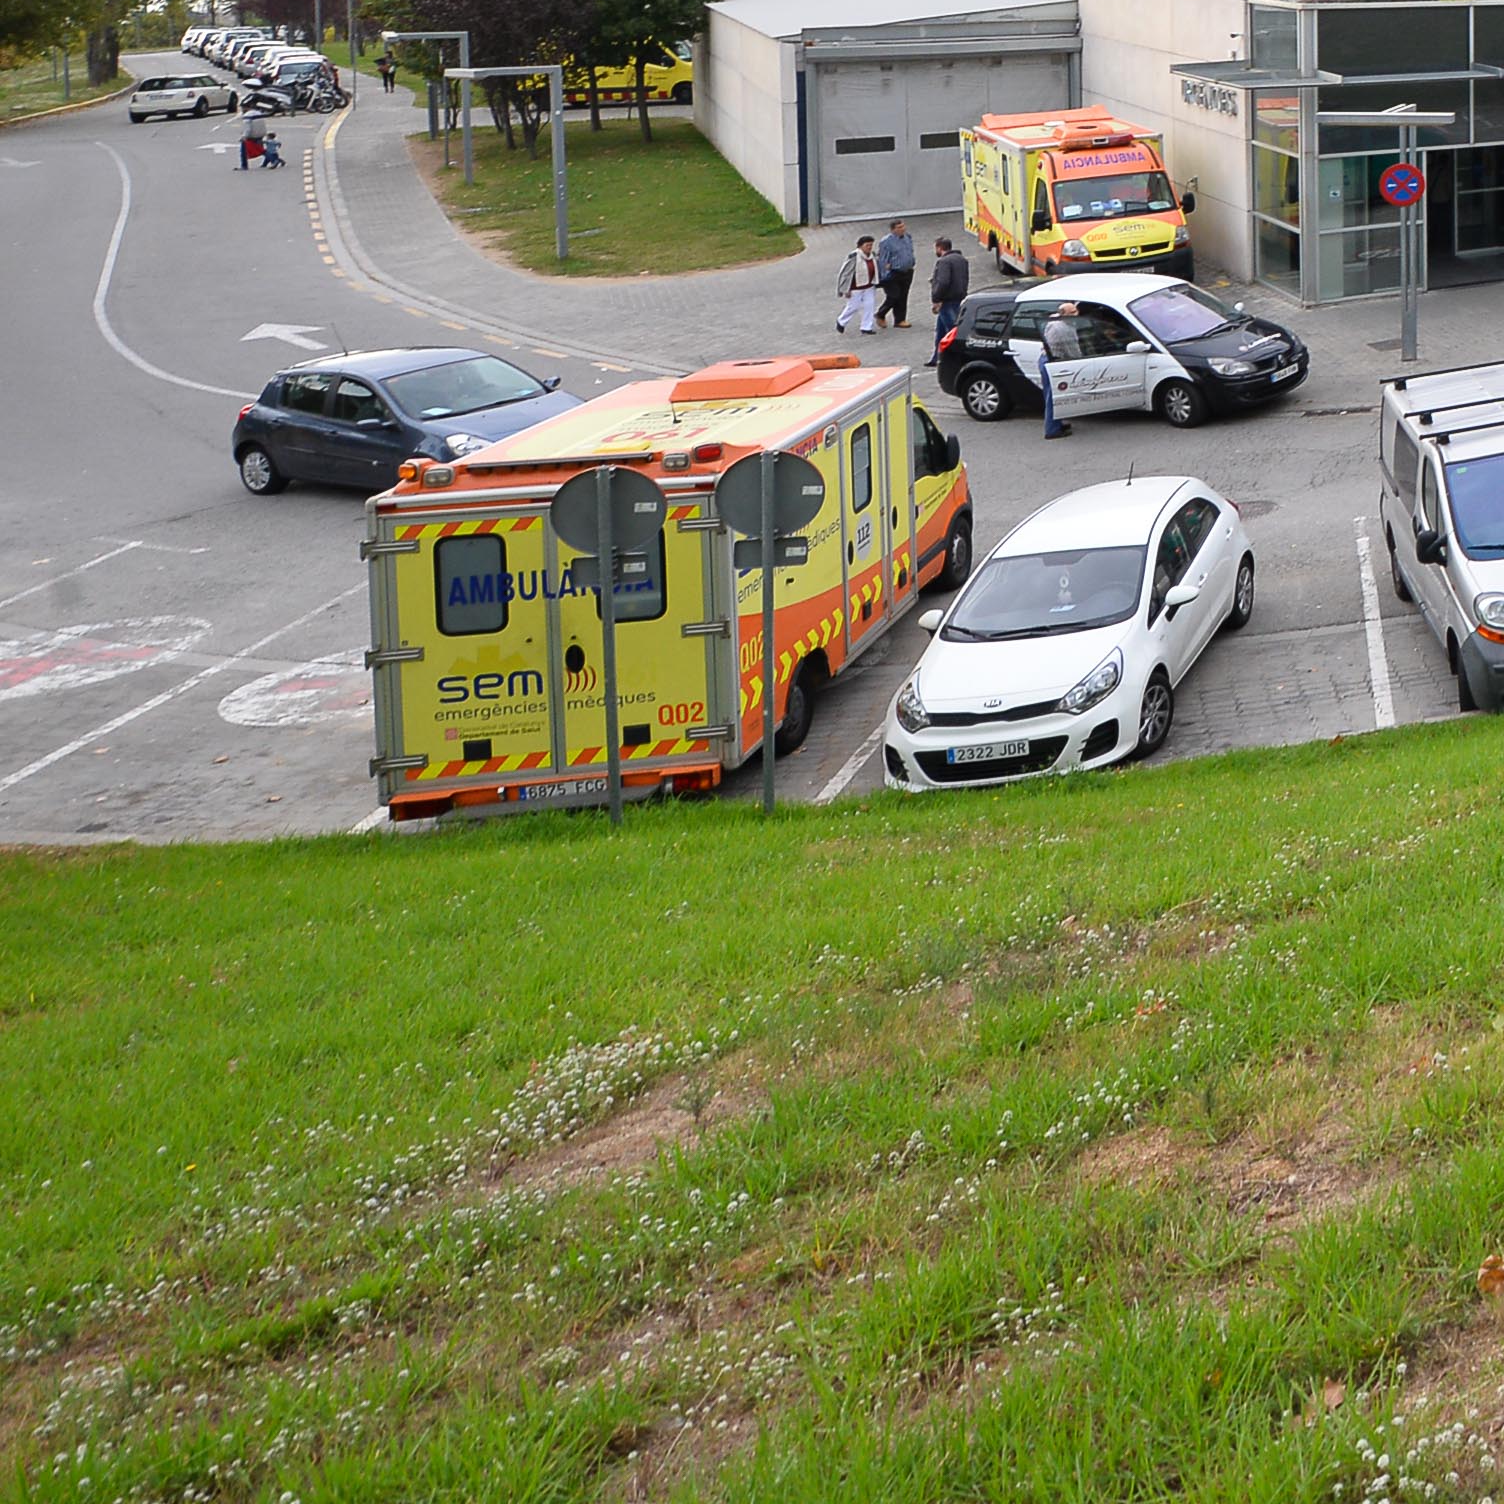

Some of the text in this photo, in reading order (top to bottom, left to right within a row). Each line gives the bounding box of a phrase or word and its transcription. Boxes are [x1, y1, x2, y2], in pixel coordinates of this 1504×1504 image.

[602, 426, 709, 444] 061
[857, 522, 871, 545] 112
[437, 669, 544, 704] sem
[434, 700, 548, 722] emergències
[658, 701, 705, 727] Q02
[957, 742, 1026, 761] 2322 JDR
